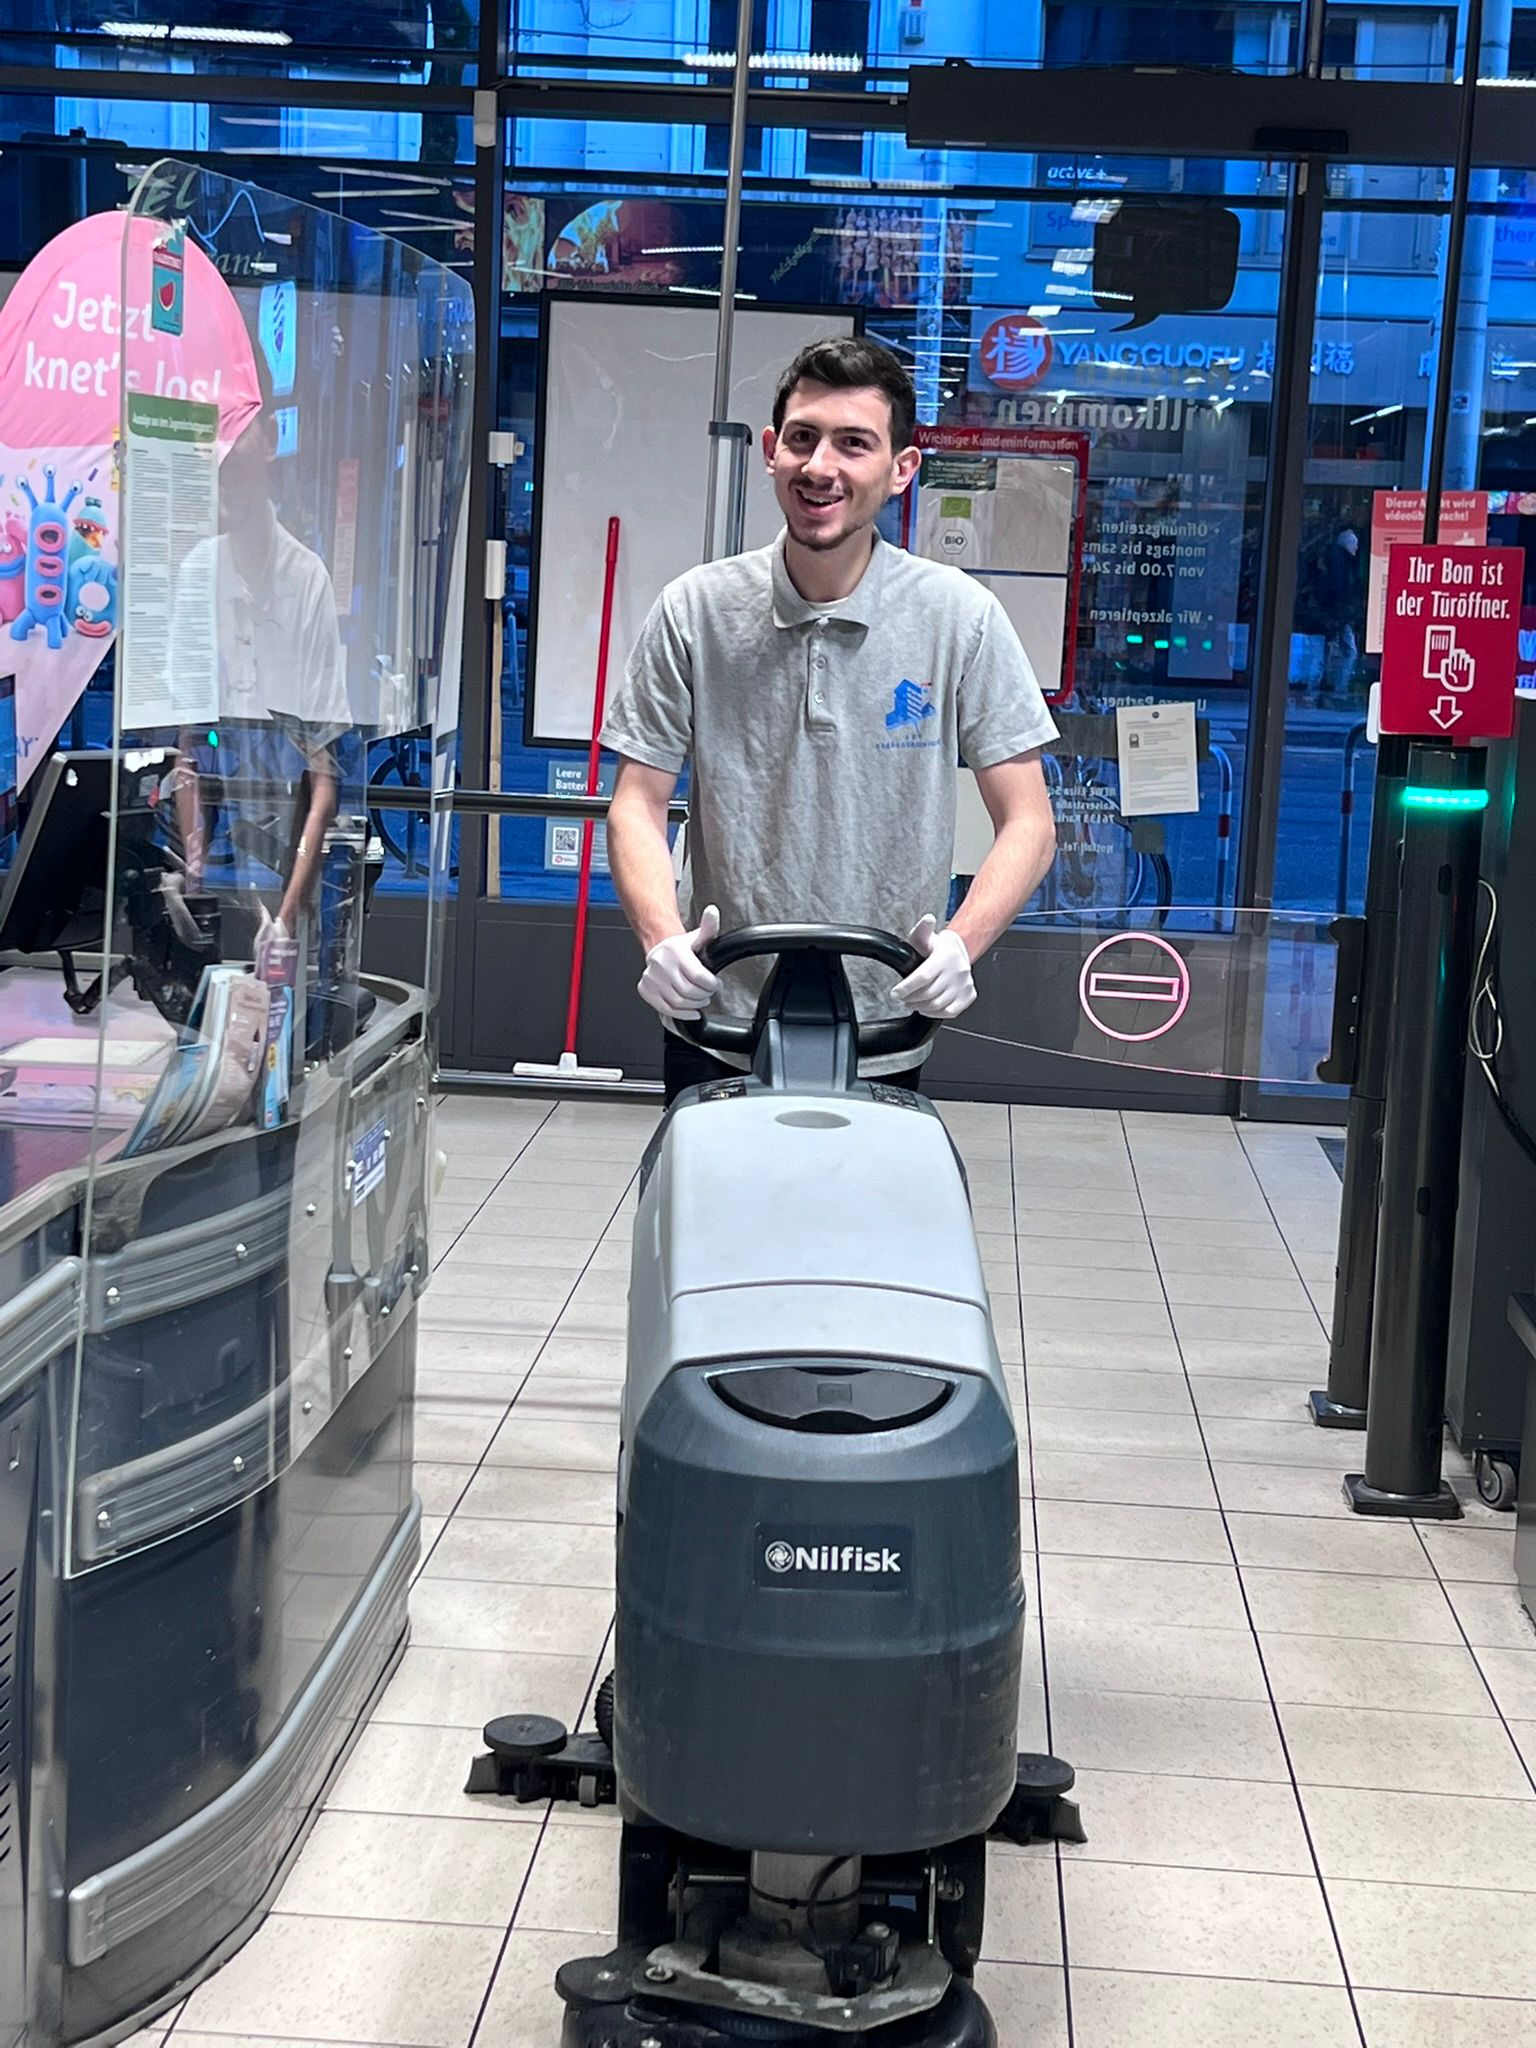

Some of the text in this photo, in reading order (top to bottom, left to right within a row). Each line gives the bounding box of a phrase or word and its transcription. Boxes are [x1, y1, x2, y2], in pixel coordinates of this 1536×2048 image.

[53, 281, 155, 342] Jetzt
[918, 431, 1079, 451] Wichtige Kundeninformation
[1385, 498, 1418, 509] Dieser
[1453, 499, 1476, 510] wird
[1408, 556, 1504, 586] Ihr Bon ist
[1396, 590, 1511, 619] der Türöffner.
[555, 767, 582, 779] Leere
[795, 1545, 902, 1573] Nilfisk
